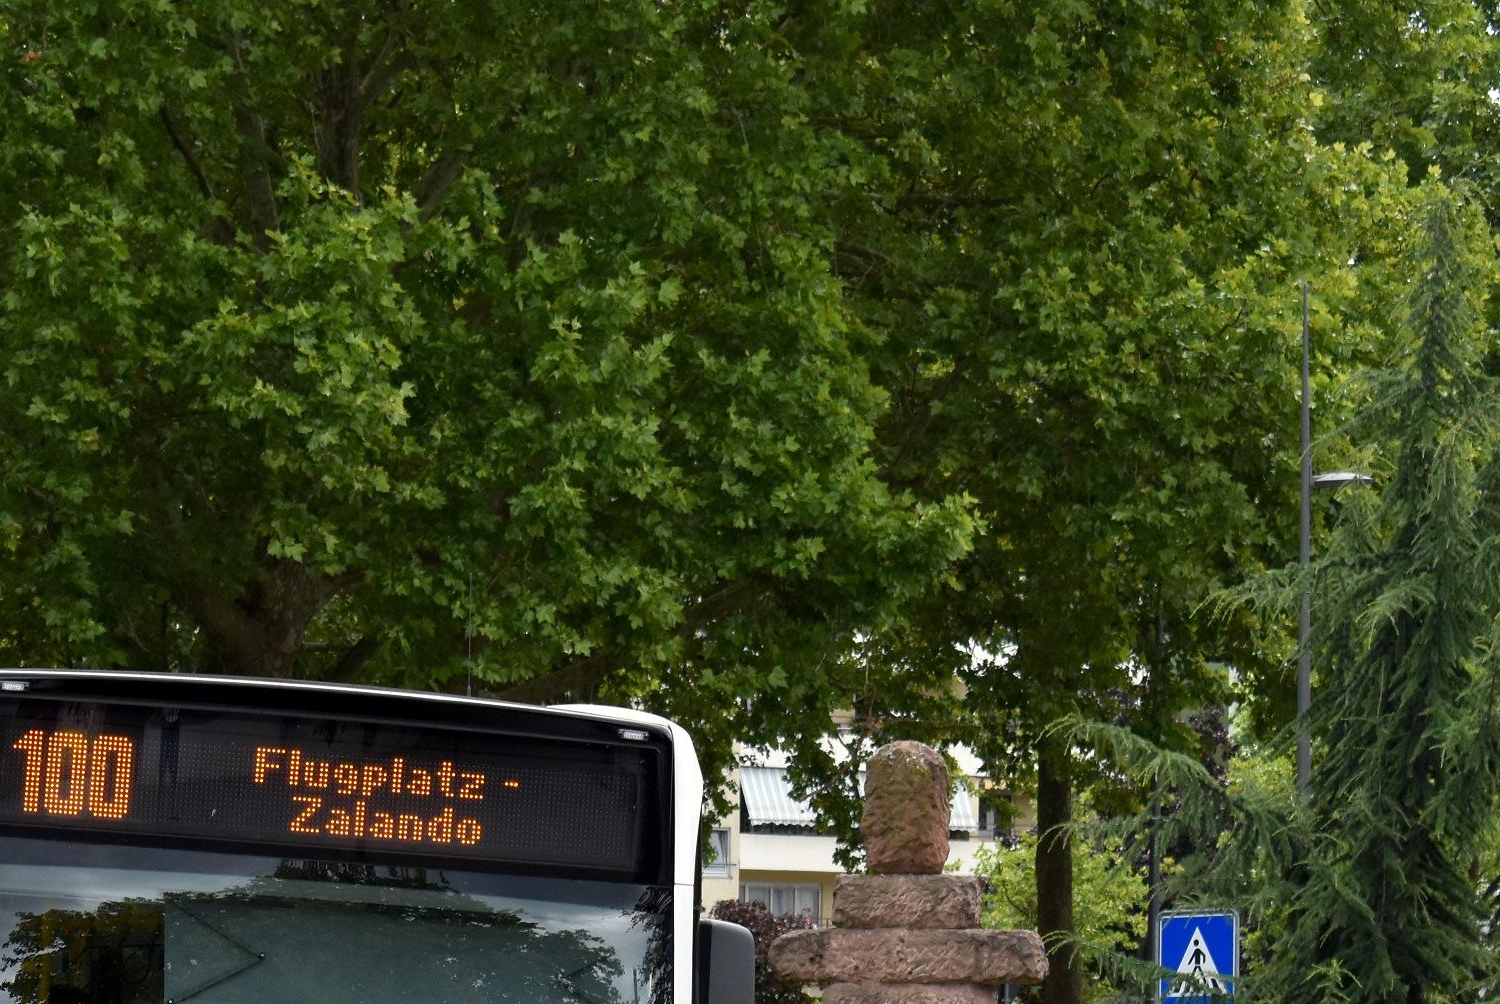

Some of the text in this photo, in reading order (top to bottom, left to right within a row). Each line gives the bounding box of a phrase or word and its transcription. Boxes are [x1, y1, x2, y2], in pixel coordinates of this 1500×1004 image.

[13, 730, 133, 818] 100
[254, 747, 485, 800] Flugplatz
[290, 796, 481, 845] Zalando
